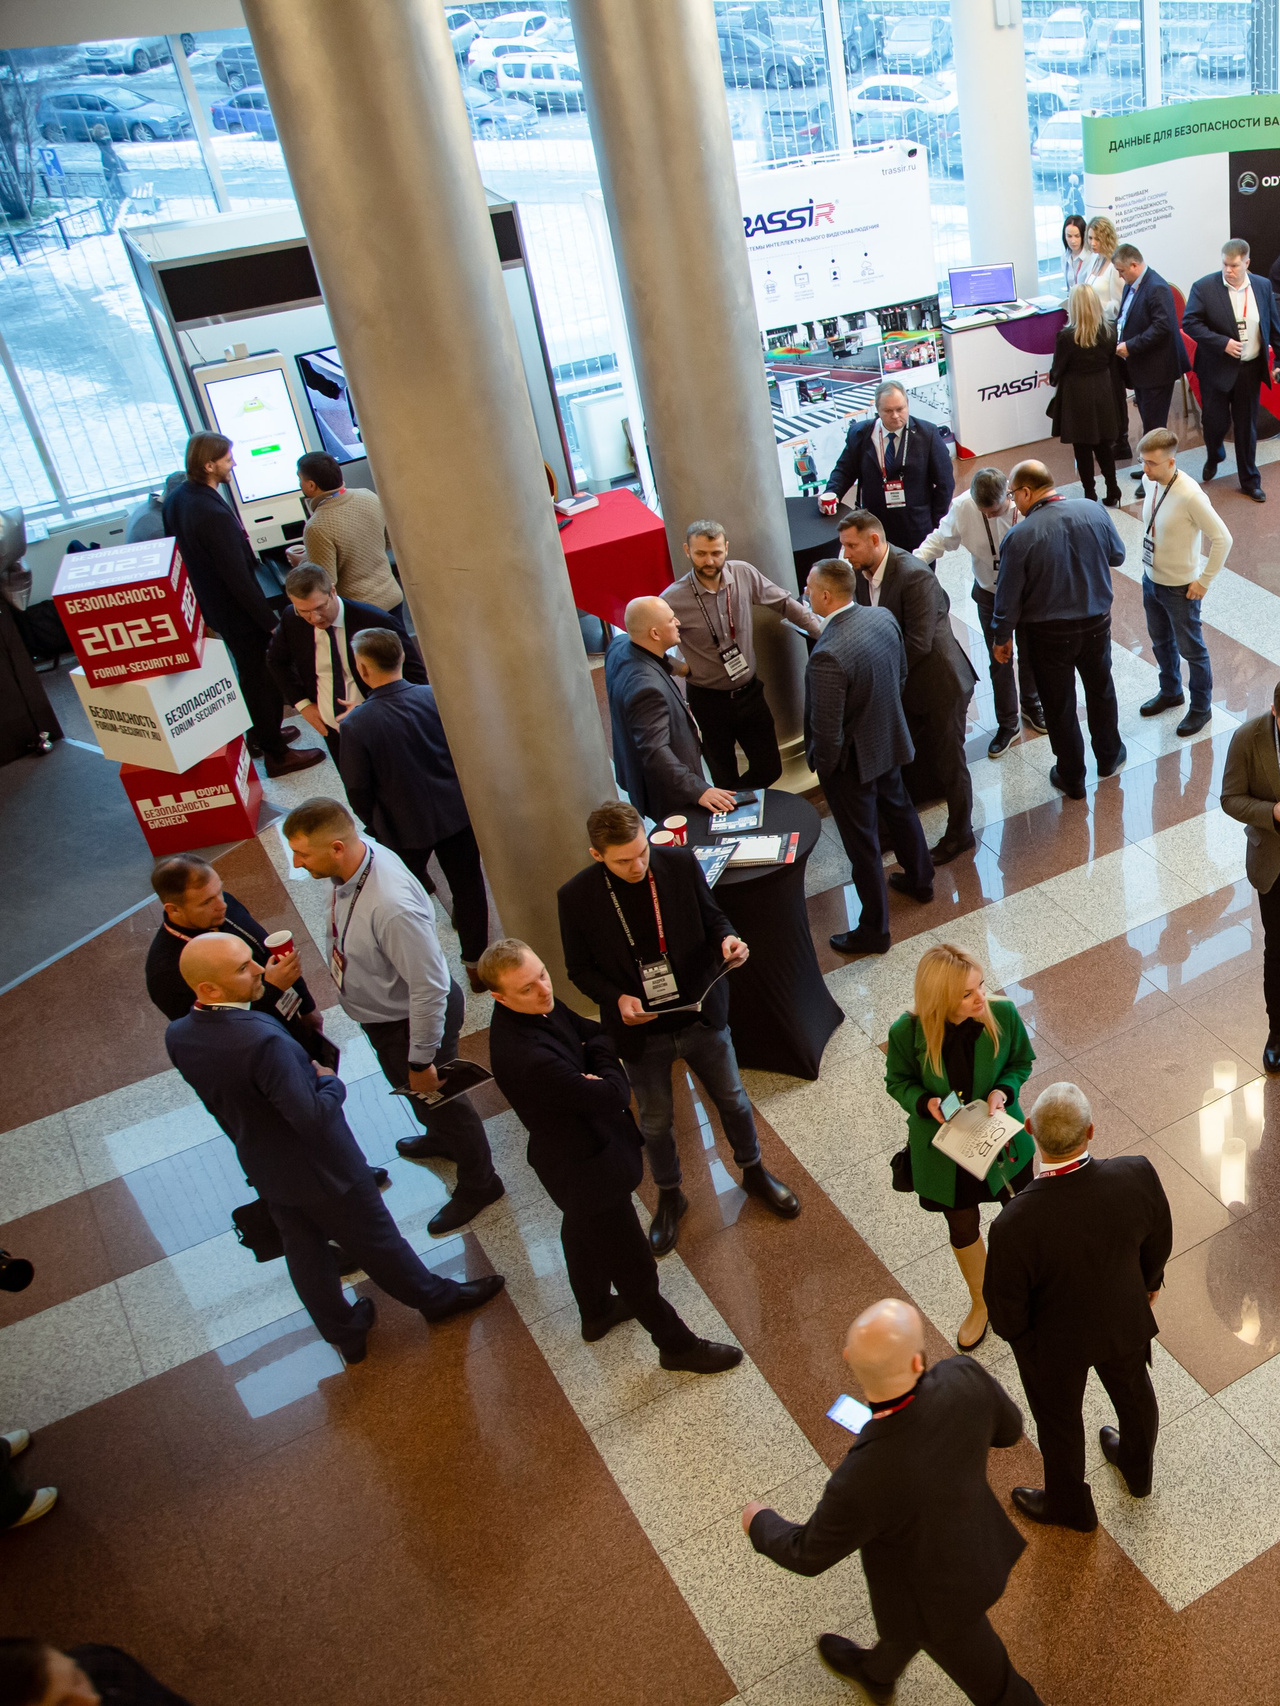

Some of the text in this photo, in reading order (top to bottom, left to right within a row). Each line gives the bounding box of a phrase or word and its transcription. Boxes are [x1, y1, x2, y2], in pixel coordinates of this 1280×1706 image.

[1109, 134, 1151, 153] ДАННЫЕ
[1153, 129, 1172, 144] ДЛЯ
[1174, 117, 1260, 138] БЕЗОПАСНОСТИ
[882, 164, 916, 176] trassir.ru
[743, 198, 836, 238] RASSIR
[766, 234, 825, 249] ИНТЕЛЛЕКТУАЛЬНОГО
[827, 224, 879, 238] ВИДЕОНАБЛЮДЕНИЯ
[71, 541, 166, 562] БЕЗОПАСНОСТЬ
[256, 536, 267, 544] CSI
[67, 554, 160, 580] 2023
[62, 570, 160, 590] FORUM-SECURITY.RU
[65, 586, 166, 614] БЕЗОПАСНОСТЬ
[78, 614, 179, 656] 2023
[93, 653, 190, 679] FORUM-SECURITY.RU
[165, 678, 233, 726] БЕЗОПАСНОСТЬ
[171, 691, 236, 738] FORUM-SECURITY.RU
[88, 705, 157, 729] БЕЗОПАСНОСТЬ
[95, 720, 162, 741] FORUM-SECURITY.RU
[196, 784, 230, 797] ФОРУМ
[144, 800, 209, 819] БЕЗОПАСНОСТЬ
[148, 815, 188, 829] БИЗНЕСА
[978, 1127, 1006, 1157] СБ
